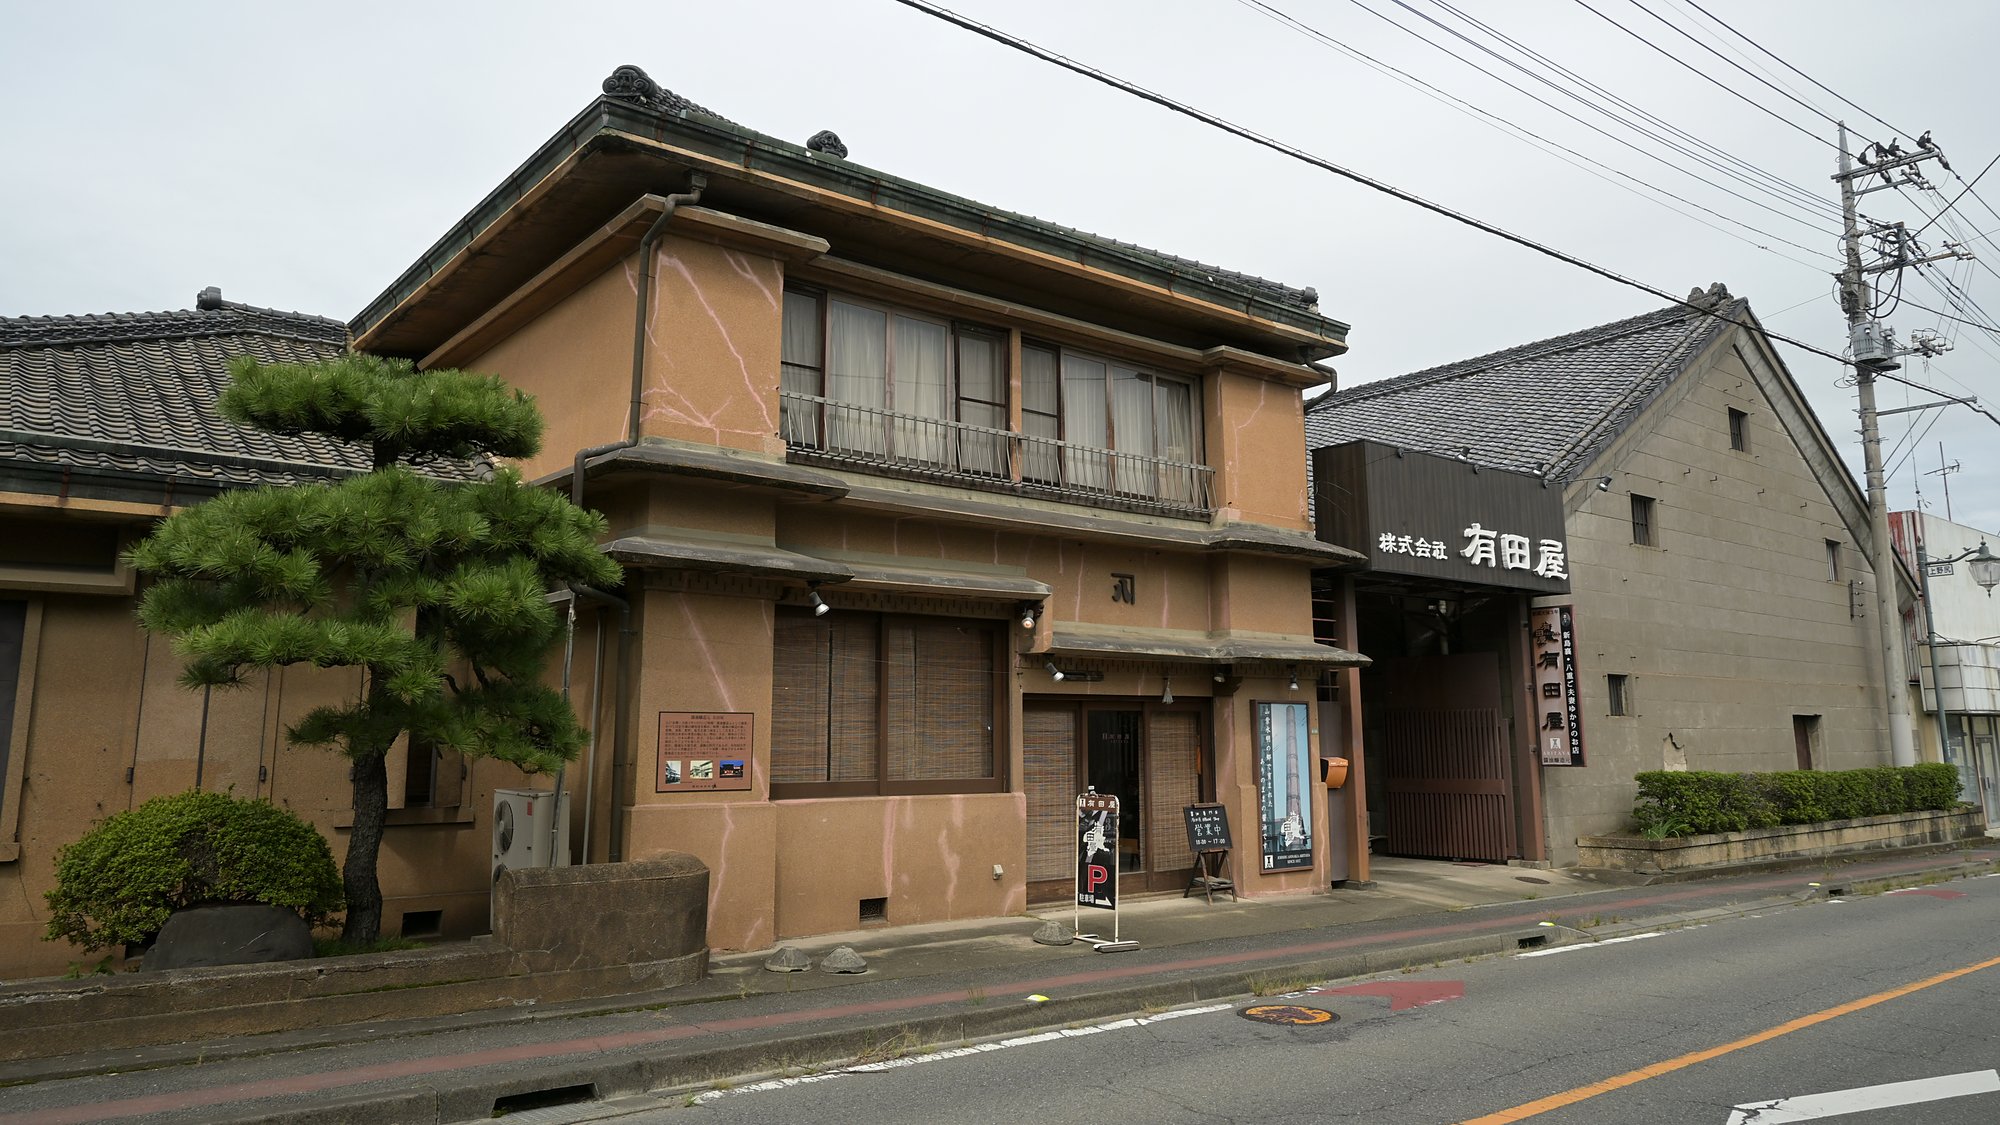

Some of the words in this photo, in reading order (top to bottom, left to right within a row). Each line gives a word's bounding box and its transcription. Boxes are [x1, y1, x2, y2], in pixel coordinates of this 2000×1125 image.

[1378, 532, 1448, 560] 株式会社
[1460, 522, 1568, 580] 有田屋
[1537, 650, 1565, 731] 有田屋
[1194, 823, 1221, 837] 営業中
[1087, 864, 1108, 893] P
